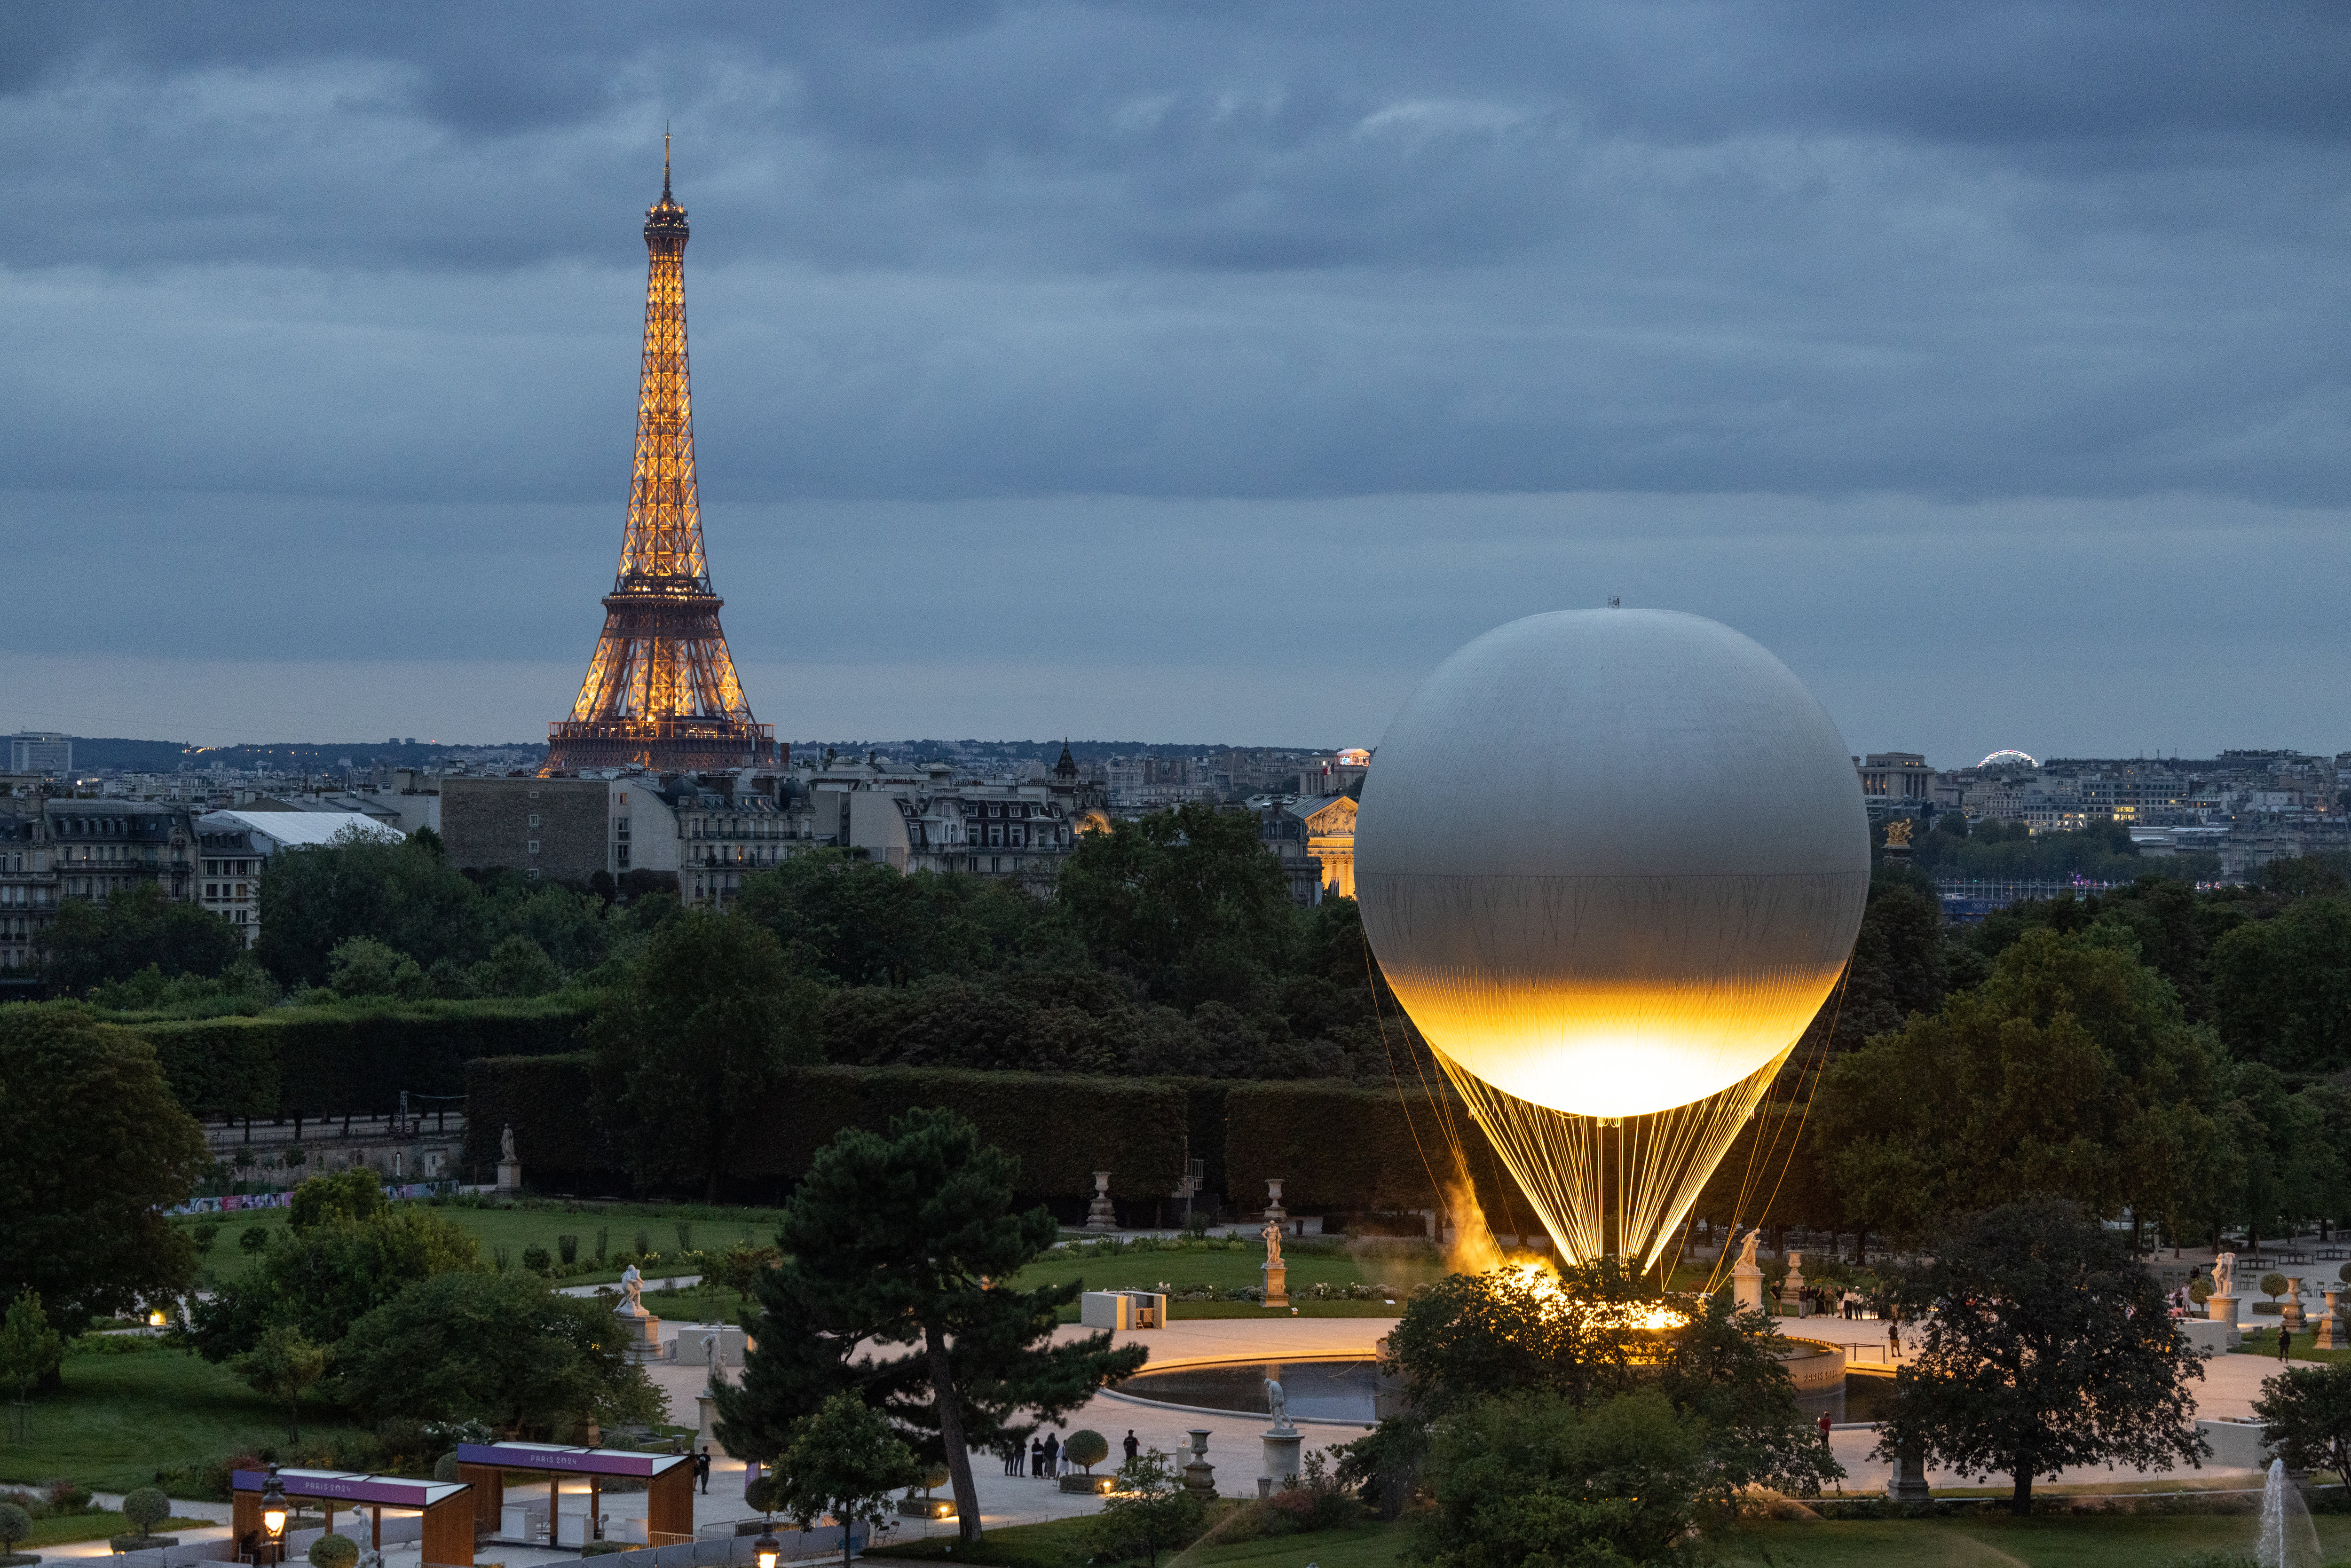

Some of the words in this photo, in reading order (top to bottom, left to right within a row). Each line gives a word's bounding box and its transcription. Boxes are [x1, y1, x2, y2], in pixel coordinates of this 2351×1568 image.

[1804, 1372, 1823, 1382] PARIS
[1825, 1370, 1837, 1379] 2024
[531, 1455, 553, 1463] PARIS
[305, 1482, 328, 1490] PARIS
[330, 1484, 351, 1493] 2024
